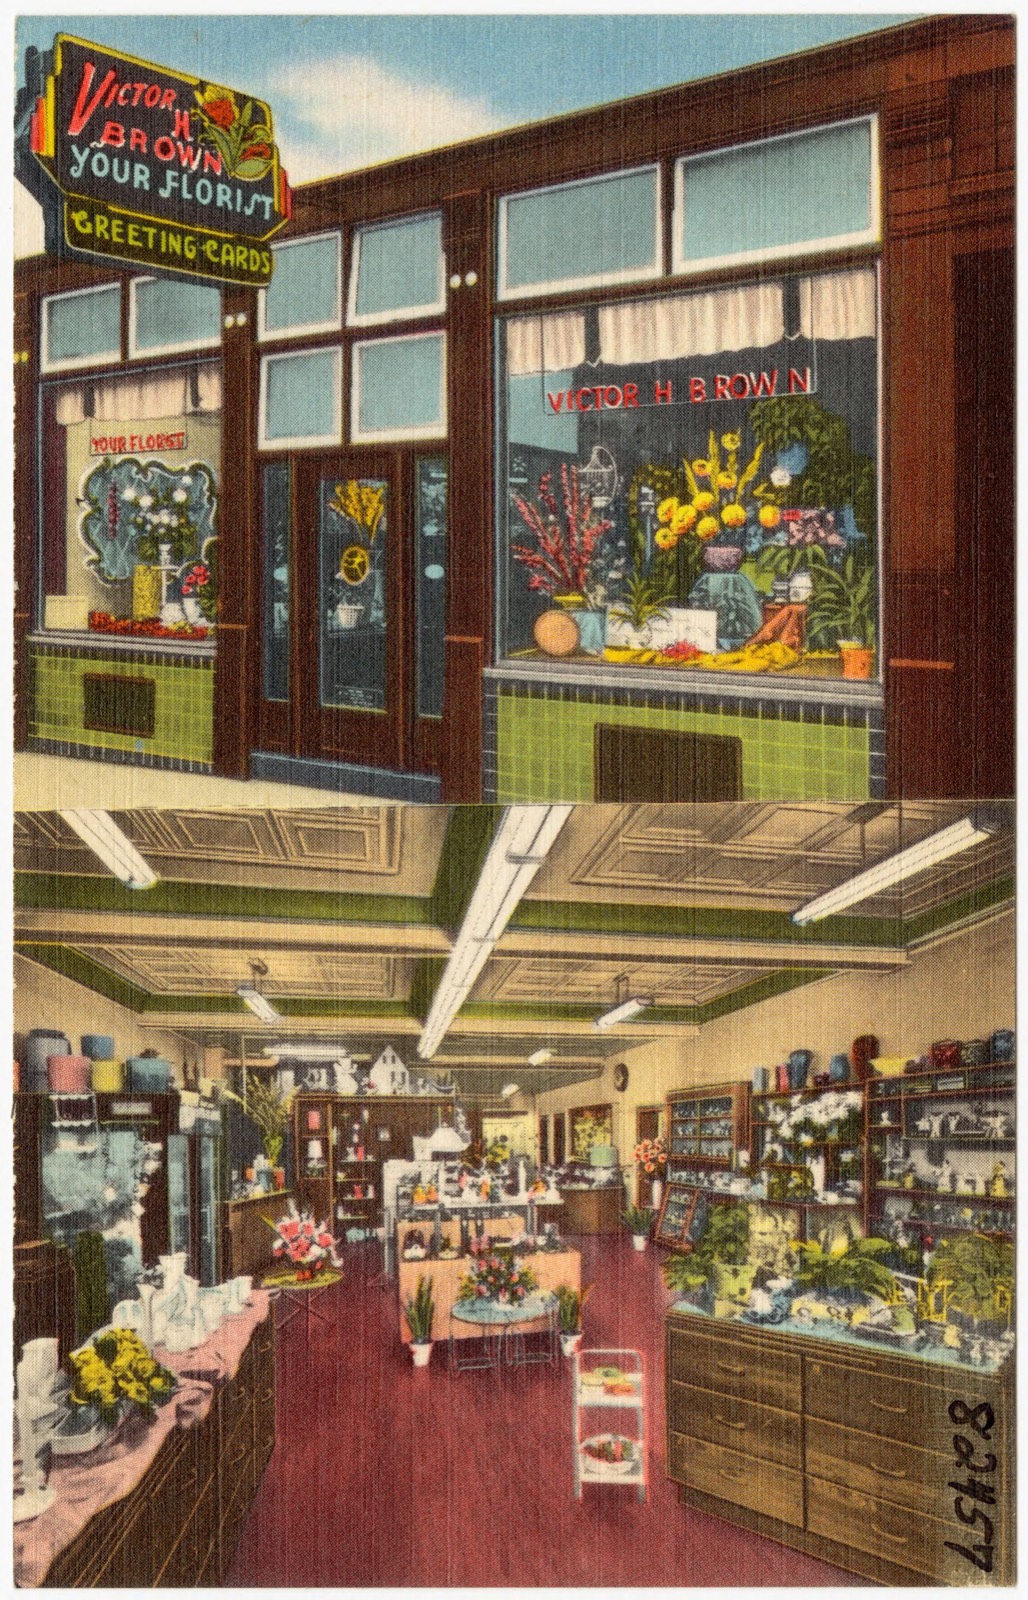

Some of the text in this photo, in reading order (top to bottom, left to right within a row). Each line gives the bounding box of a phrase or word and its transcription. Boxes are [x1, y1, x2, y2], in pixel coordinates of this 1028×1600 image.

[67, 61, 177, 136] VICTOR
[172, 109, 193, 142] H
[89, 120, 223, 176] BROWN
[69, 144, 274, 221] YOUR FLORIST
[71, 210, 270, 274] GREETING CARDS
[547, 367, 812, 414] VICTOR H BROWN
[92, 435, 126, 453] YOUR
[944, 1400, 998, 1572] 82457
